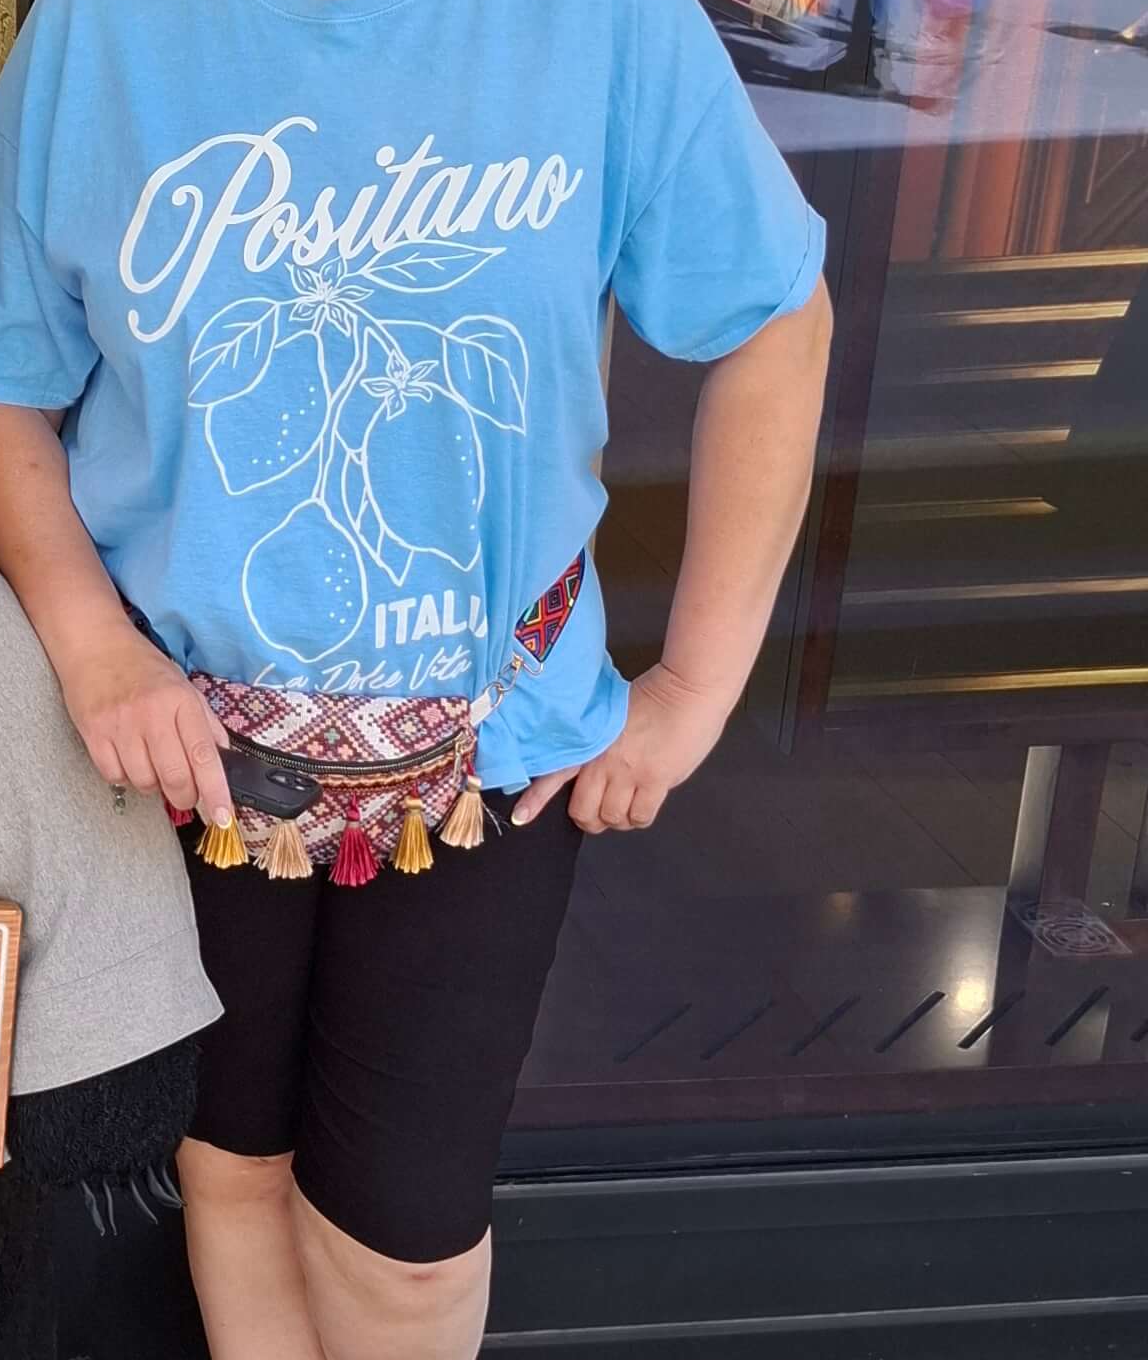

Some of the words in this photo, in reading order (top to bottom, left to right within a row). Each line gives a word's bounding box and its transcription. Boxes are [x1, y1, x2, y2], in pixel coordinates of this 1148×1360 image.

[119, 116, 583, 342] Positano
[375, 589, 488, 649] ITALI
[253, 662, 309, 689] La
[315, 660, 403, 693] Dolce
[409, 644, 472, 690] Vita
